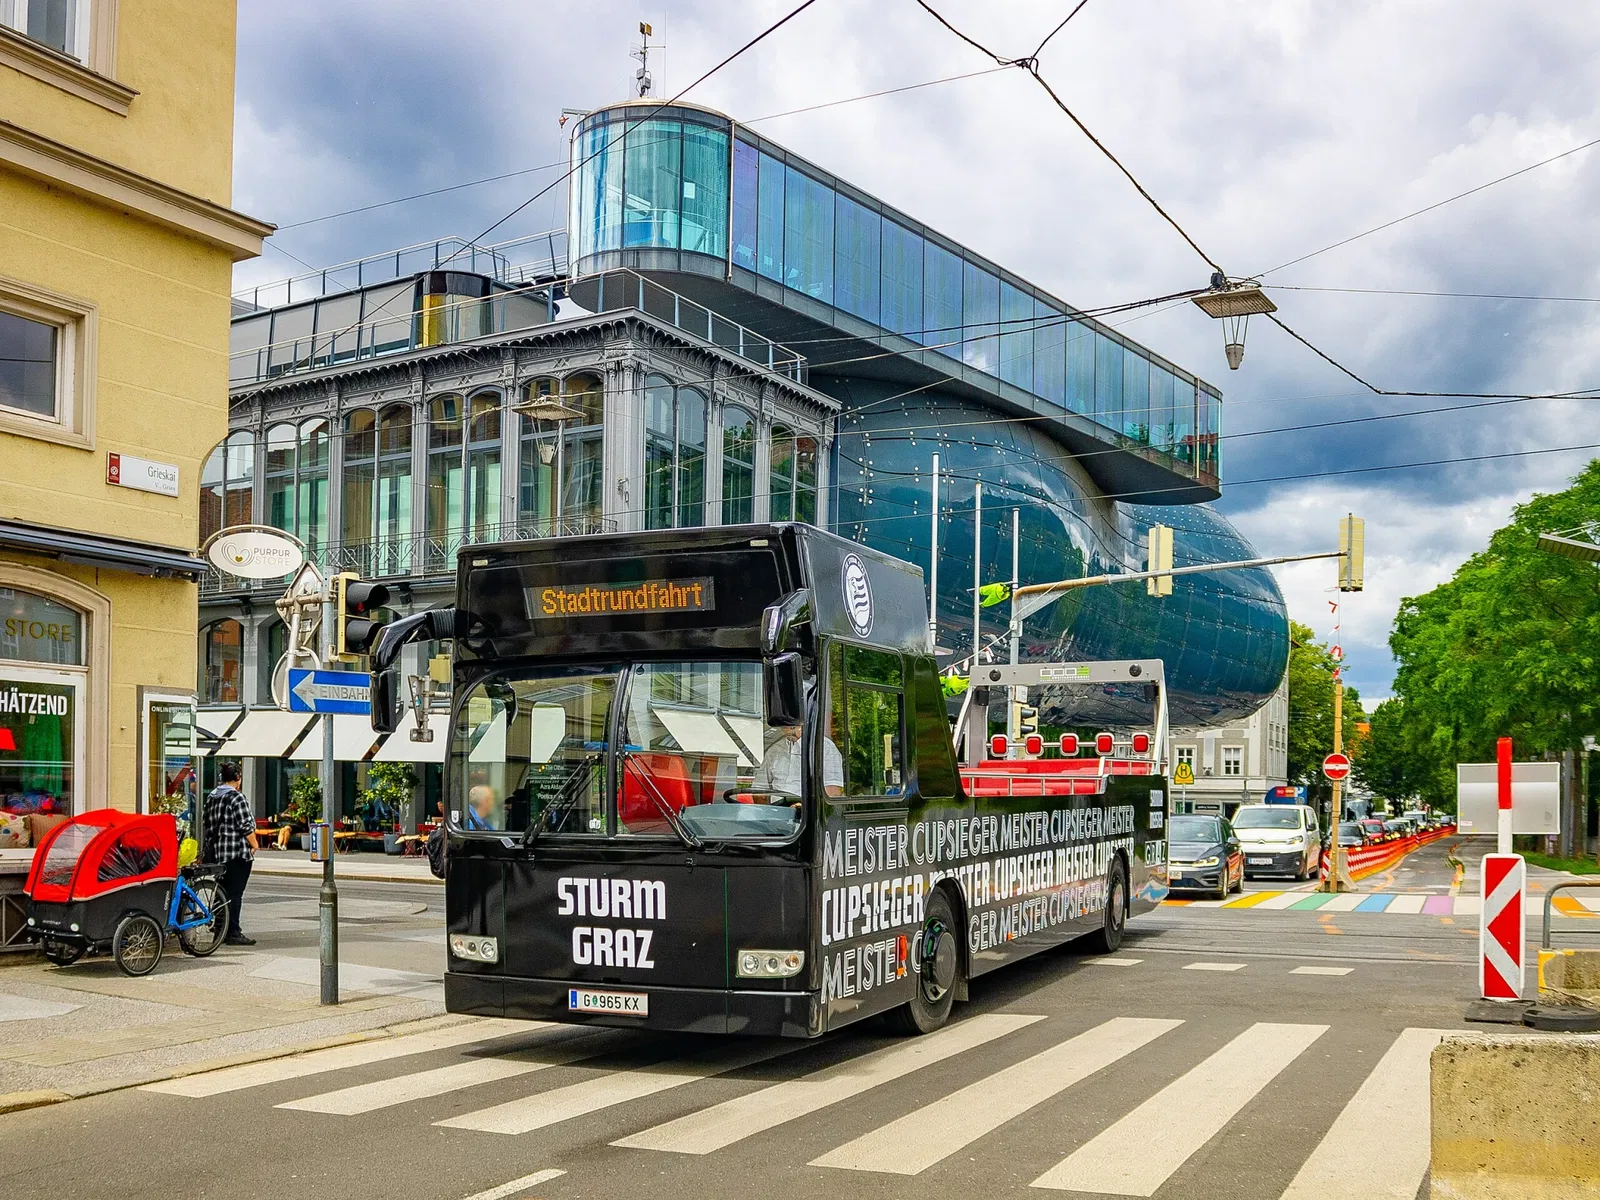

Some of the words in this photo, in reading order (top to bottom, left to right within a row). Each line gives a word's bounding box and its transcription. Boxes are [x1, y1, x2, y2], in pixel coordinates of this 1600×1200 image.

[147, 465, 176, 482] Grieskai
[253, 547, 291, 557] PURPUR
[255, 556, 291, 566] STORE
[541, 581, 703, 614] Stadtrundfahrt
[5, 618, 73, 643] STORE
[319, 686, 371, 701] EINBAHN
[822, 824, 909, 880] MEISTER
[912, 815, 998, 866] CUPSIEGER
[999, 811, 1049, 850] MEISTER
[1050, 807, 1102, 843] CUPSIEGER
[1102, 805, 1134, 836] MEISTER
[557, 877, 666, 920] STURM
[821, 874, 924, 946] CUPSIEGER
[994, 849, 1054, 902] CUPSIEGER
[1055, 843, 1094, 886] MEISTER
[998, 895, 1048, 943] MEISTER
[1049, 881, 1101, 926] CUPSIEGER
[572, 926, 655, 969] GRAZ
[584, 994, 590, 1007] G
[600, 995, 621, 1009] 965
[625, 996, 639, 1010] KX
